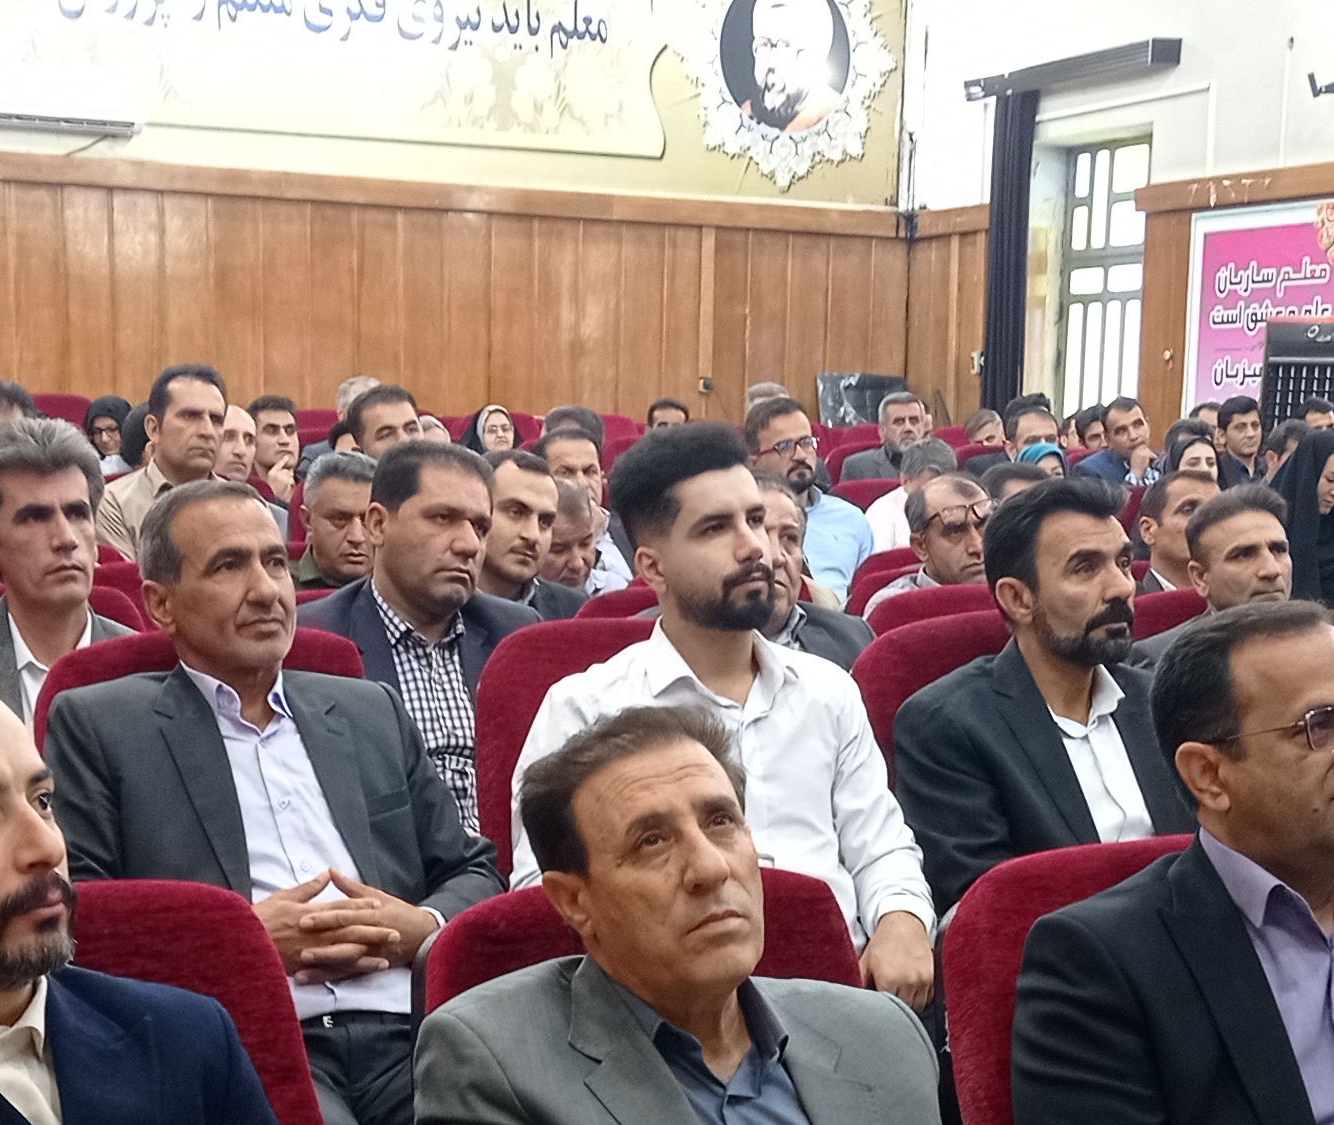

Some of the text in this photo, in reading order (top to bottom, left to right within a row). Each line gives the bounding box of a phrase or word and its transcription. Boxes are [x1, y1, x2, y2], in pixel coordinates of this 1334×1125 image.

[492, 0, 540, 52] باید
[551, 0, 607, 58] معلم
[1217, 258, 1329, 296] معلم ساربان
[1210, 302, 1244, 328] است
